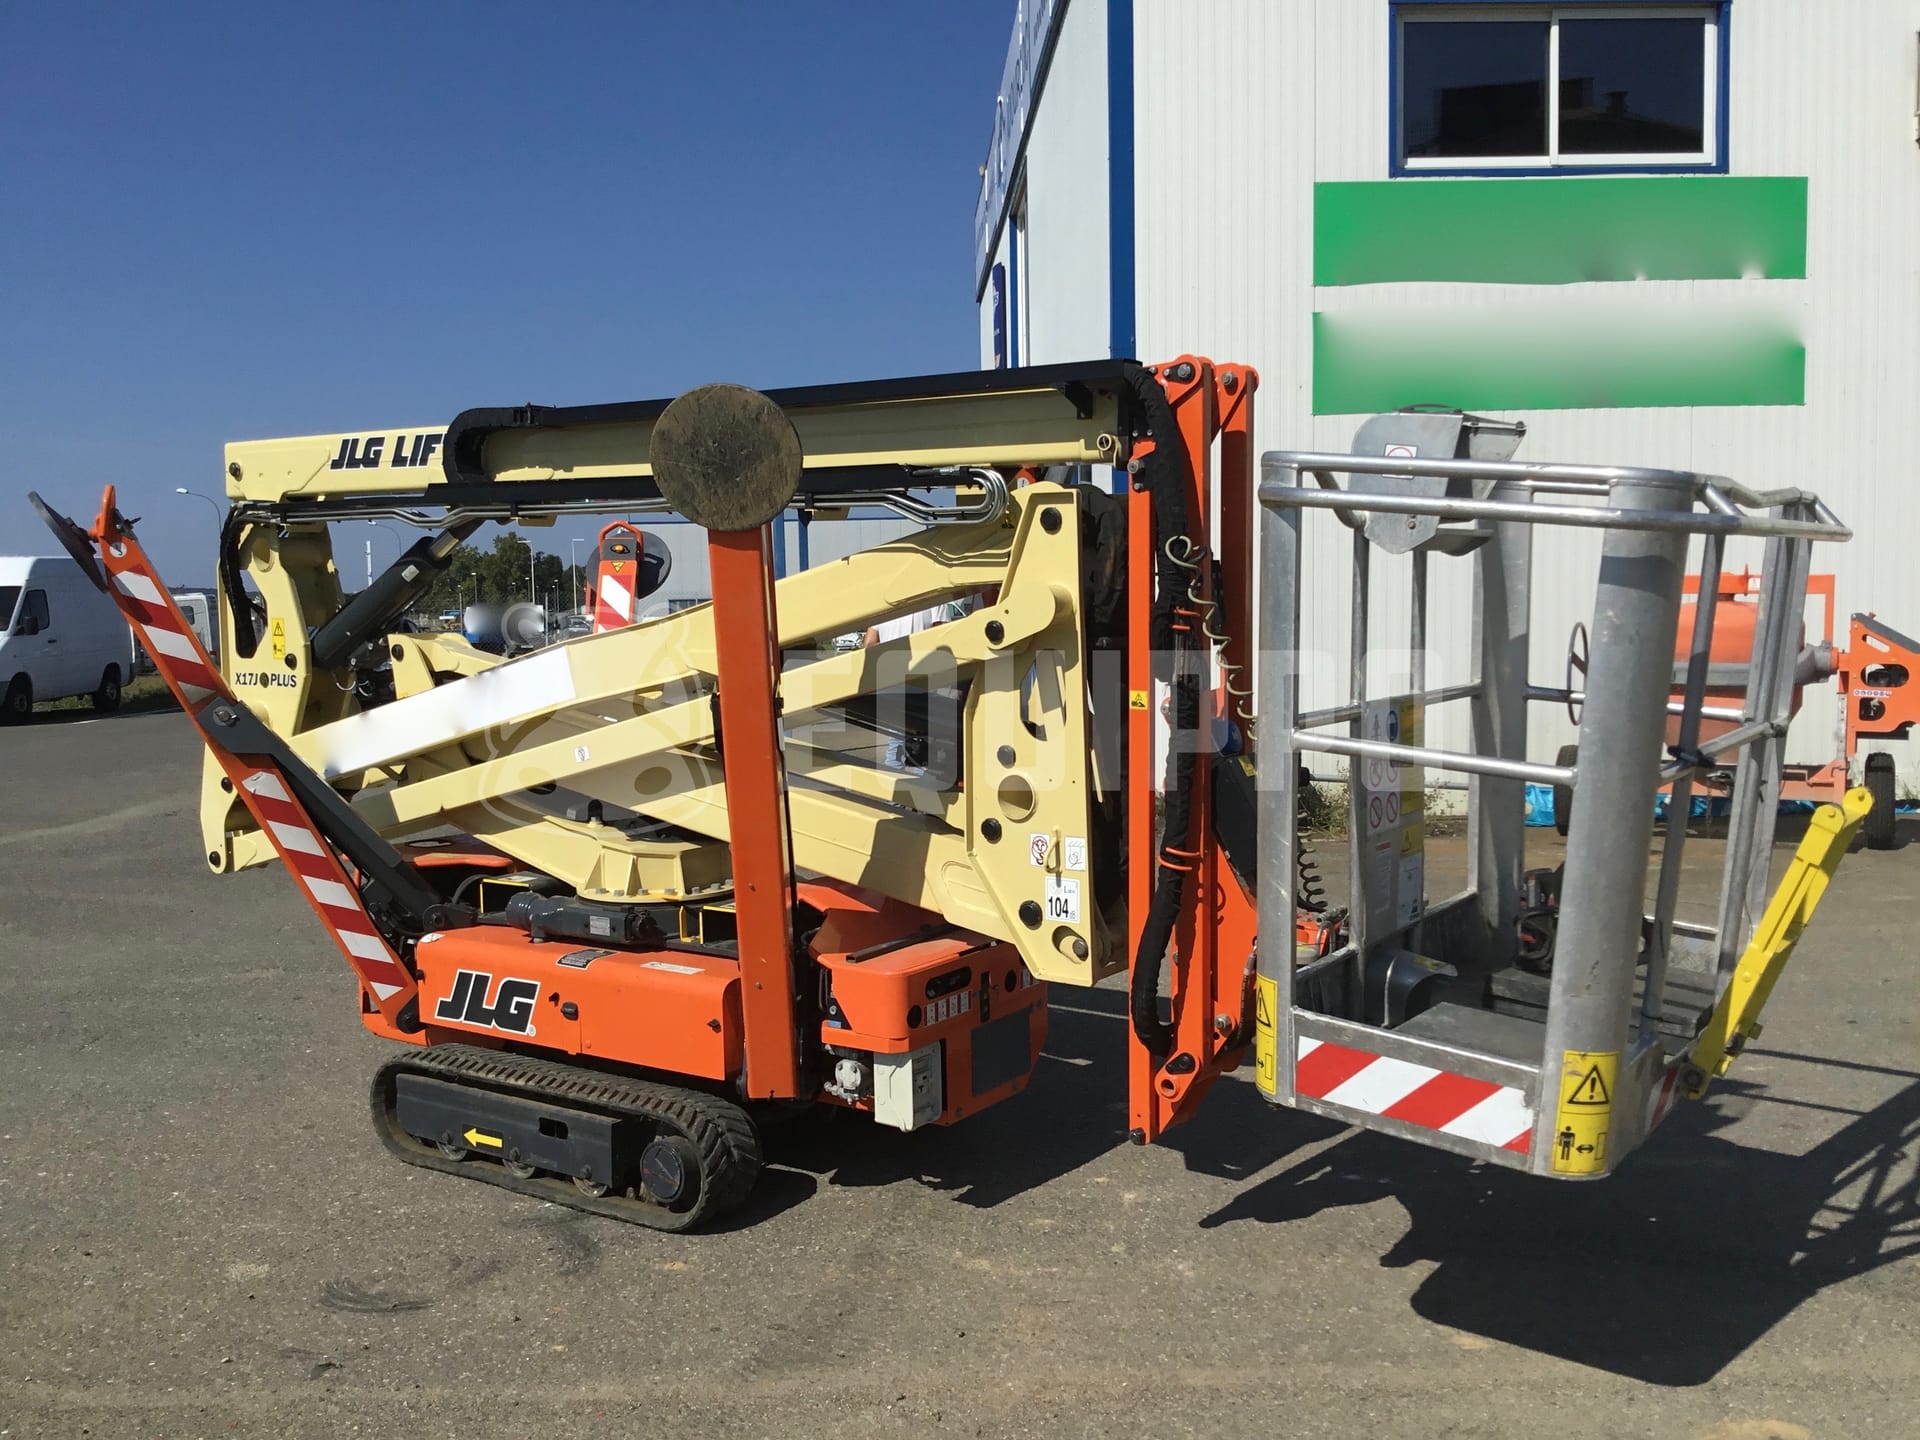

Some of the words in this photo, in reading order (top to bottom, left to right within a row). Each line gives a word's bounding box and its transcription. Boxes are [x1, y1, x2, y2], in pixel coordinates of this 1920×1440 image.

[329, 436, 386, 470] JLG
[390, 432, 448, 468] LIF
[235, 672, 258, 686] X17J
[270, 673, 297, 688] PLUS
[1048, 896, 1069, 918] 104
[434, 969, 541, 1035] JLG
